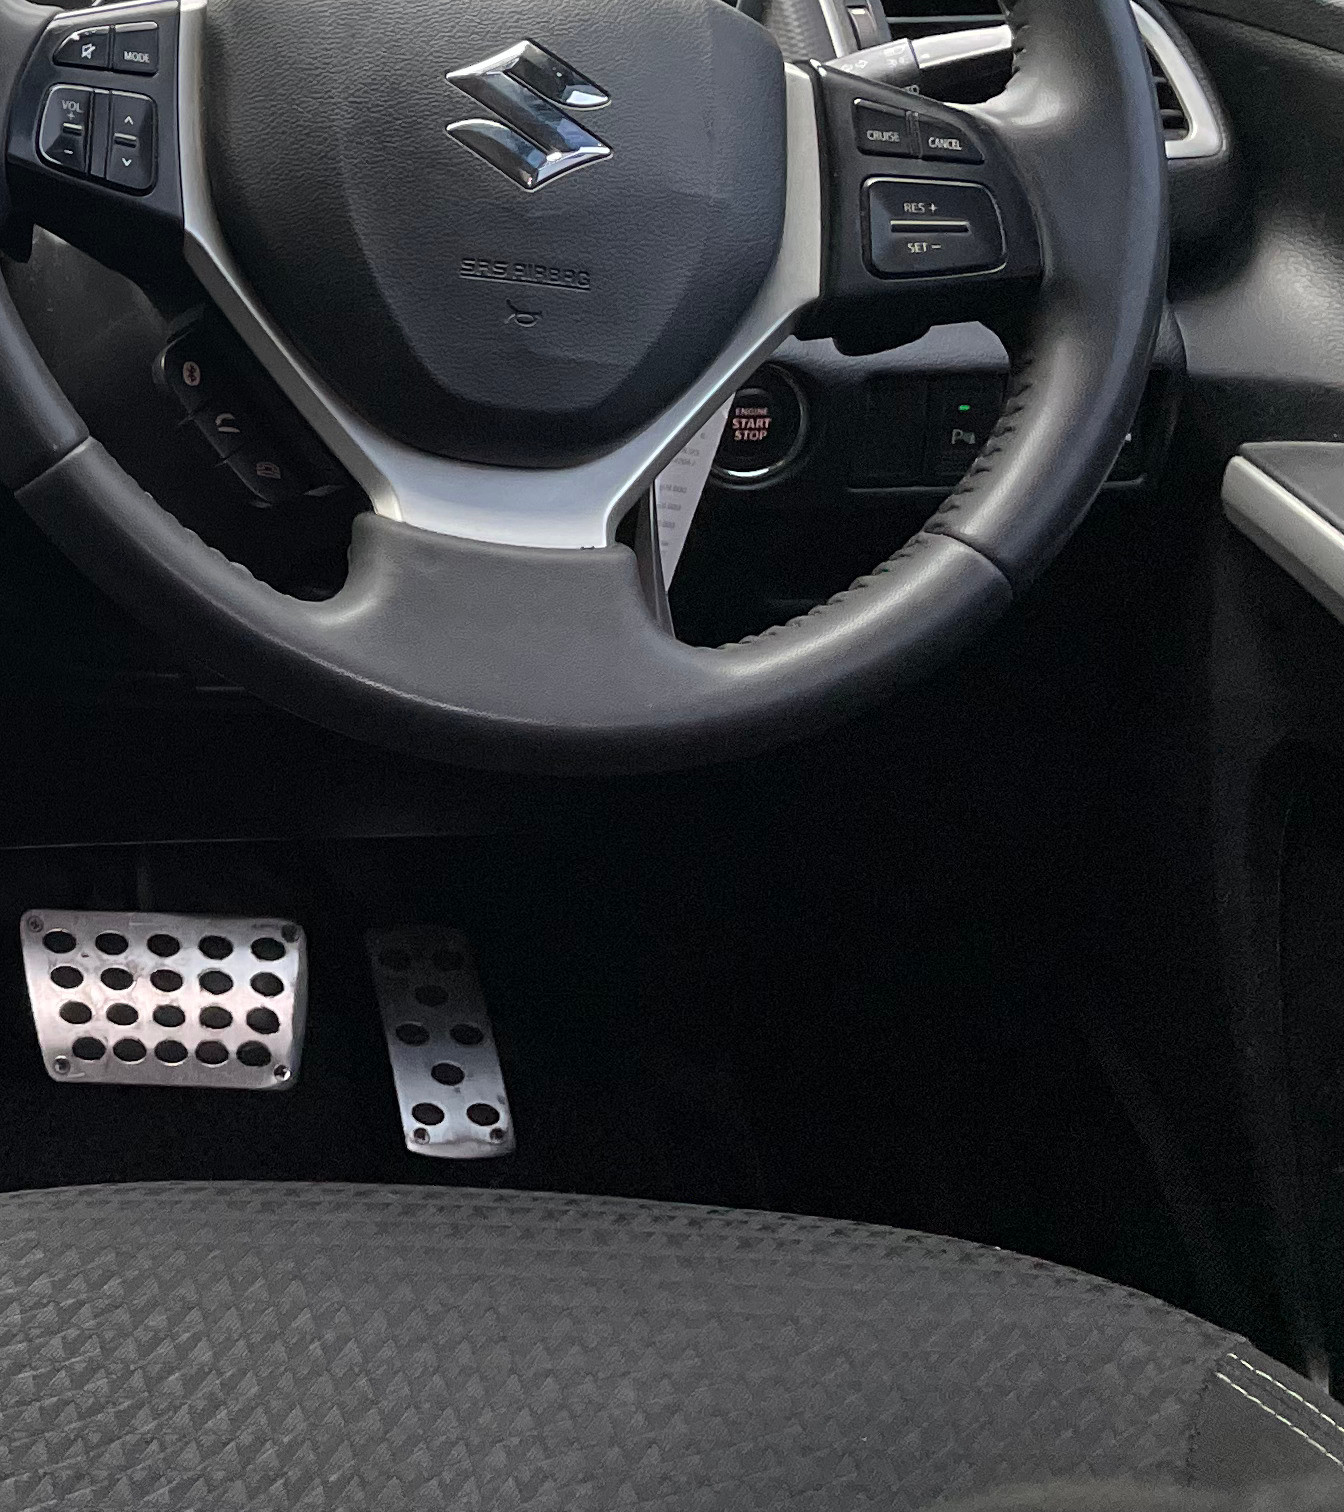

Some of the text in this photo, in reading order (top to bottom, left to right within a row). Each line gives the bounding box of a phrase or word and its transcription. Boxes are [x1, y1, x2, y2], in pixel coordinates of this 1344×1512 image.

[123, 50, 150, 64] MODE
[62, 99, 84, 113] VOL
[866, 129, 901, 143] CRUISE
[928, 136, 962, 151] CANCEL
[903, 202, 925, 213] RES
[907, 242, 928, 253] SET
[460, 257, 591, 289] SRS AIRBAG
[735, 407, 768, 416] ENGINE
[732, 418, 772, 429] START
[734, 430, 767, 441] STOP
